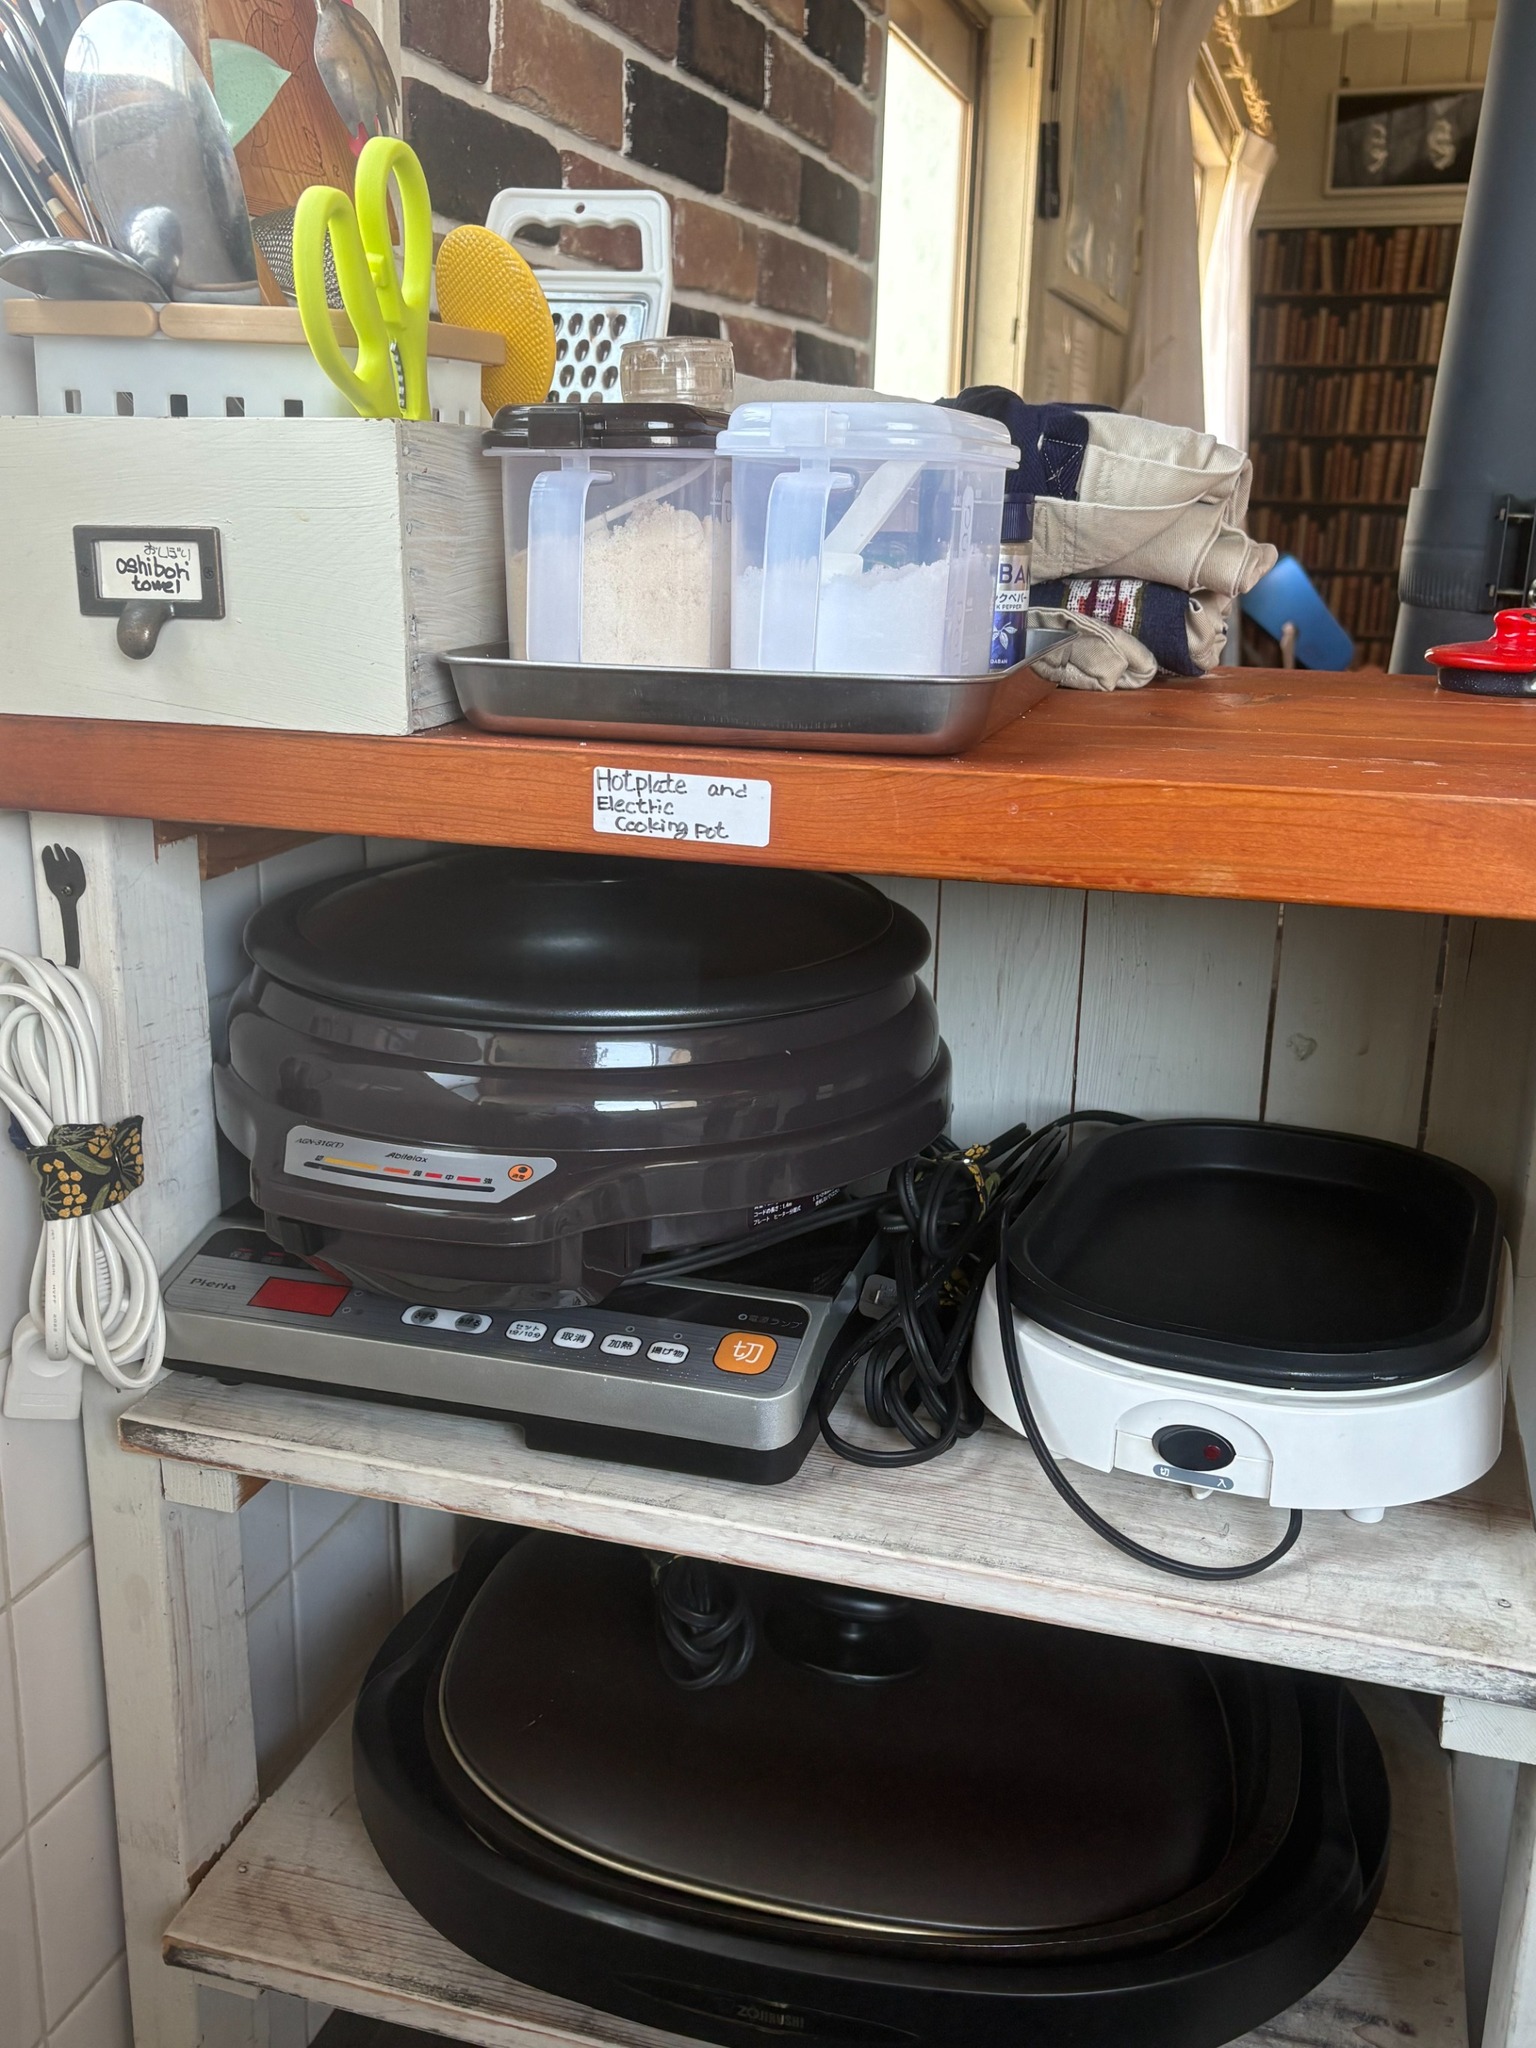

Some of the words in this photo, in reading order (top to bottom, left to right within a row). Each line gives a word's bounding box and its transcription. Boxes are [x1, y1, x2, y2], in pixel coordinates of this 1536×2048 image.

[143, 542, 191, 561] おしぼり
[131, 575, 181, 594] towel
[596, 768, 688, 798] Hotplate
[707, 783, 748, 799] and
[596, 795, 675, 816] Electric
[614, 816, 689, 840] Cooking
[384, 1151, 429, 1165] Abitelax
[515, 1323, 540, 1332] セット
[560, 1331, 587, 1344] 取消
[607, 1339, 634, 1351] 加熱
[651, 1346, 686, 1359] 揚げ物
[733, 1340, 765, 1364] 切
[1160, 1467, 1170, 1477] 切
[1217, 1478, 1227, 1489] 入
[736, 2005, 805, 2029] ZOJIRUSHI
